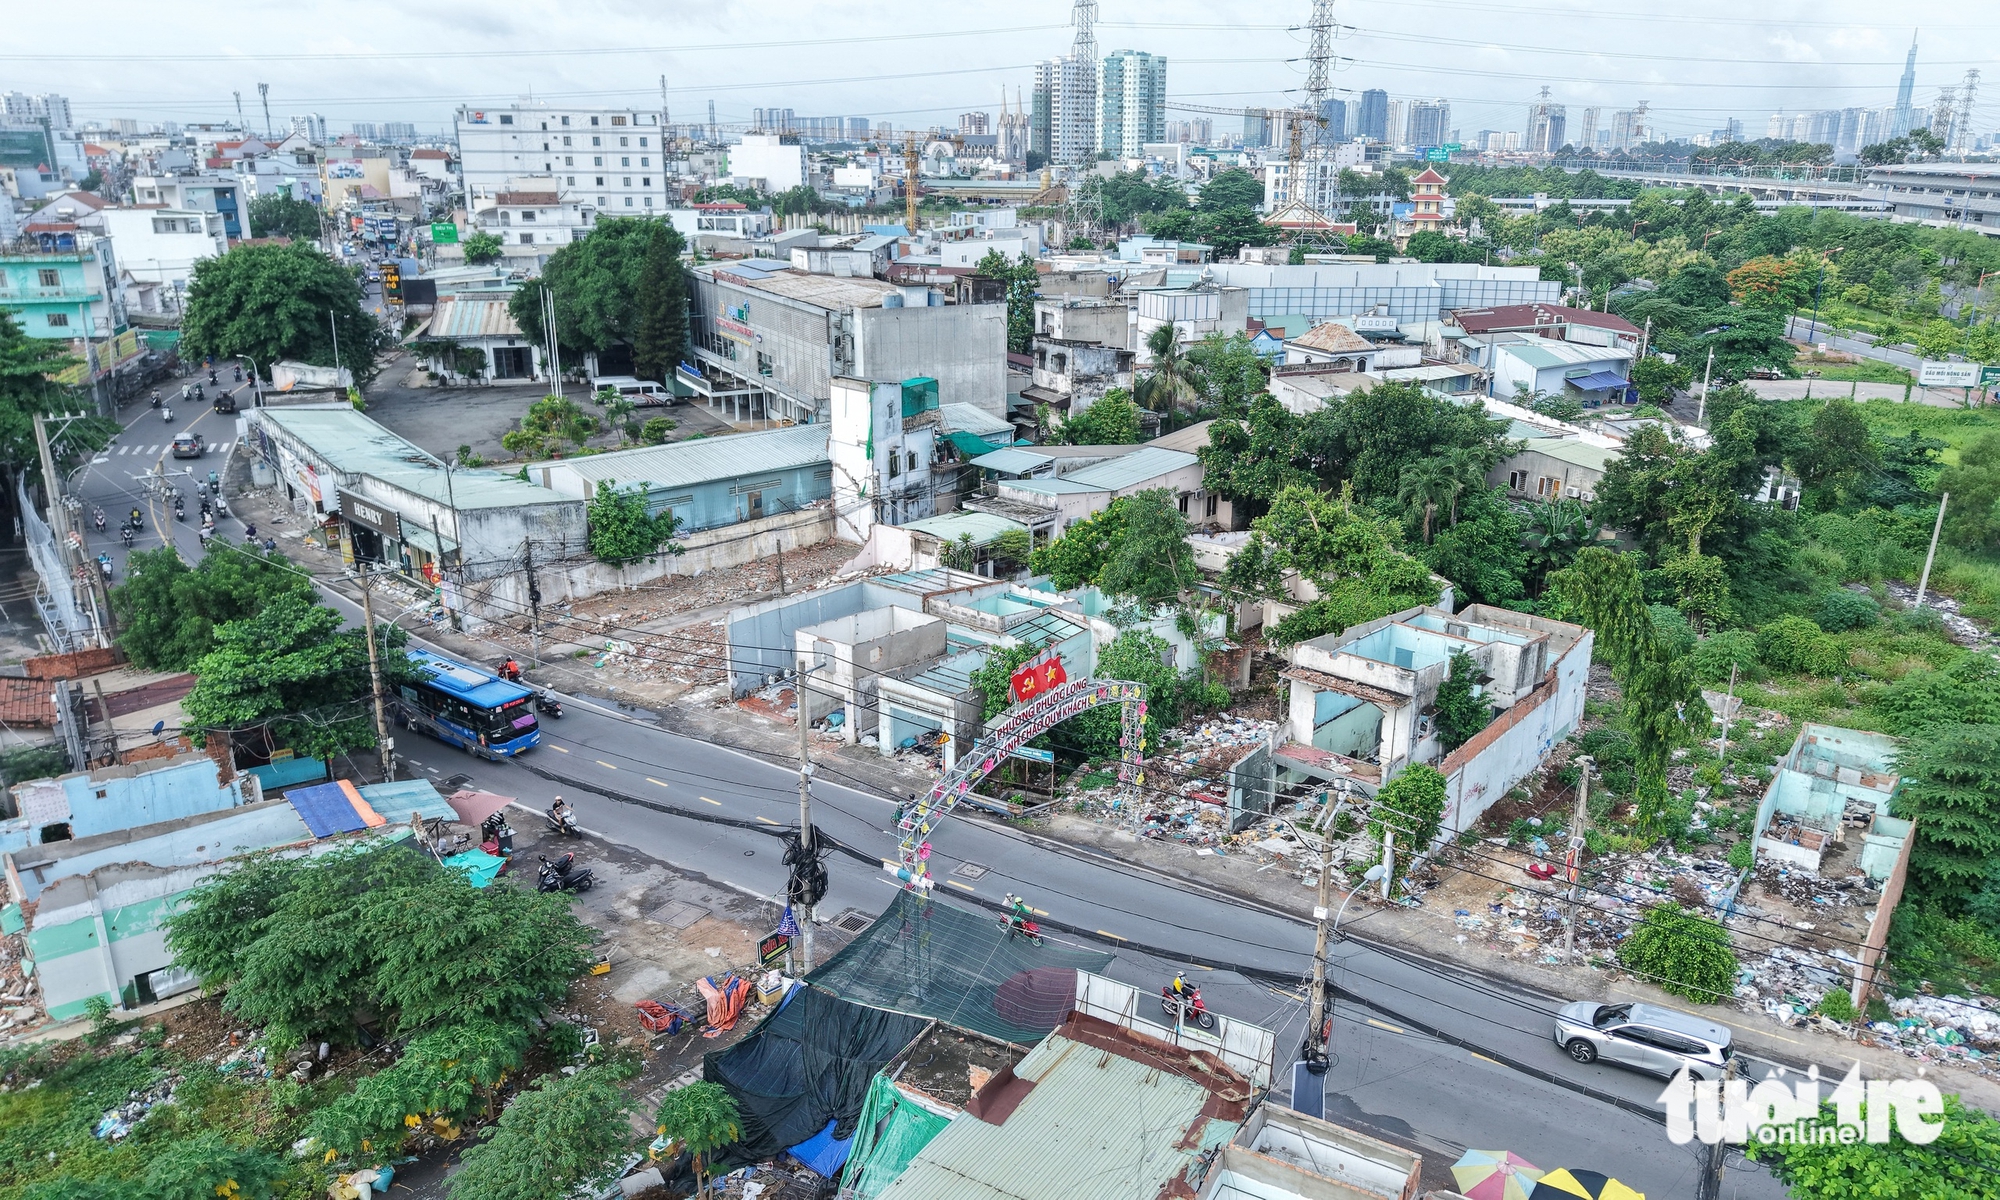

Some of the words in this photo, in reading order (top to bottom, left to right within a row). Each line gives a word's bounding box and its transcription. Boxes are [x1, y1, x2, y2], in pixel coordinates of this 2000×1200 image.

[354, 502, 382, 525] HENRY
[1065, 677, 1087, 697] LONG
[1062, 696, 1087, 718] KHÁCH
